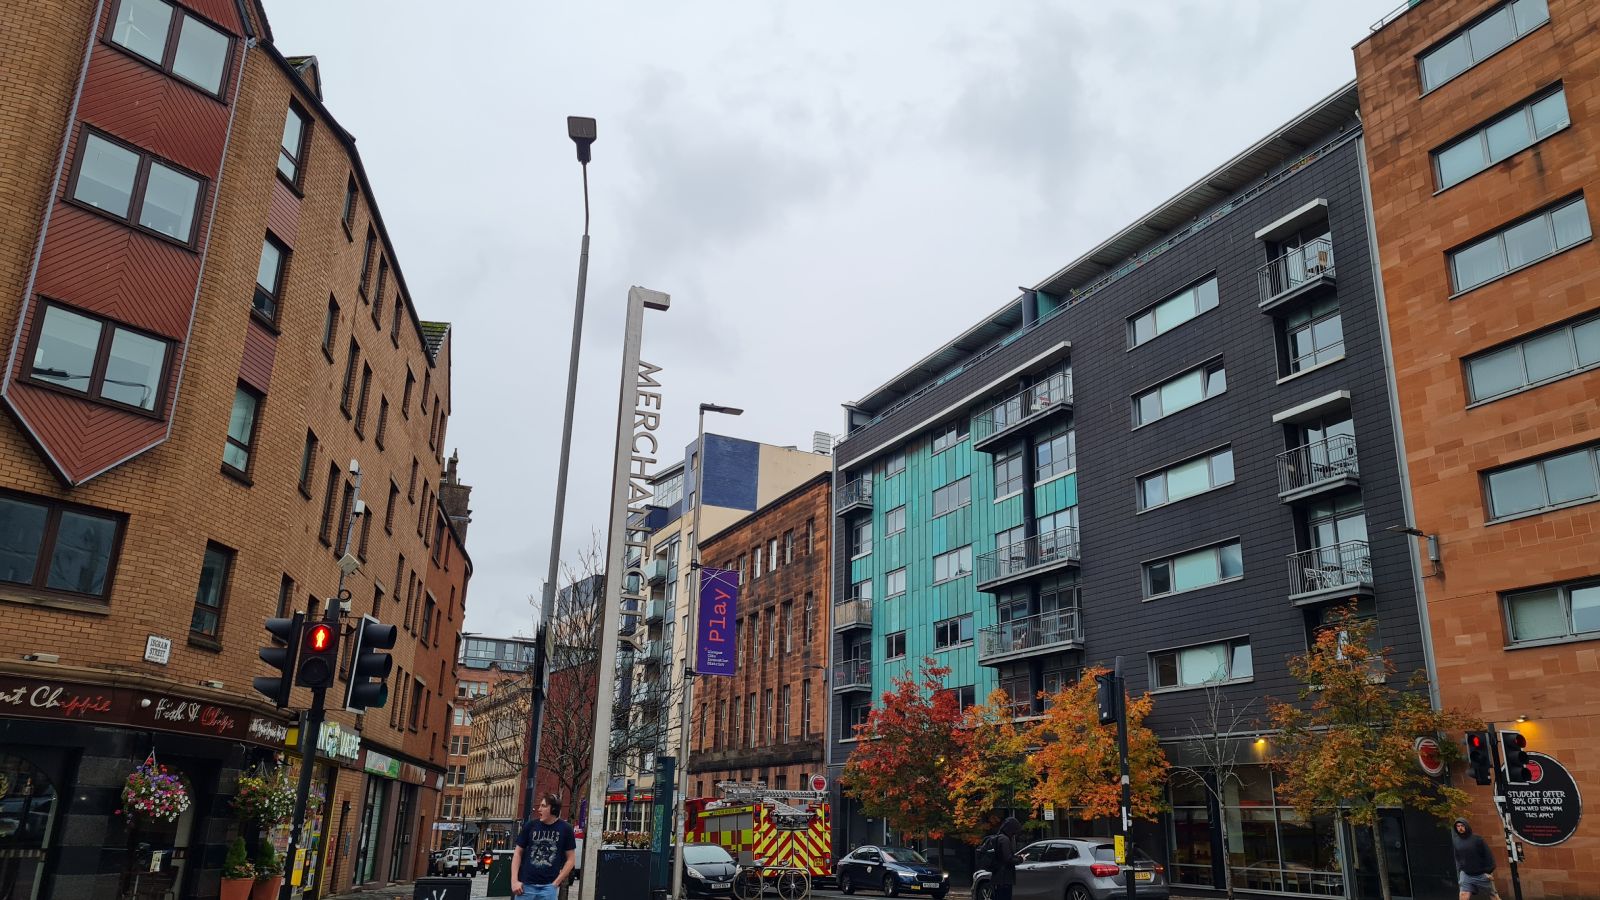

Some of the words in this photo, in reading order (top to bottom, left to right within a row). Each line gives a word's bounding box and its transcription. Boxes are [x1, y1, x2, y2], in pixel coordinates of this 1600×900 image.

[625, 360, 663, 557] MERCHANT
[618, 567, 648, 653] CITY
[709, 588, 731, 642] Play
[149, 648, 166, 657] STREET
[30, 685, 112, 716] Chippie
[155, 698, 187, 721] Fish
[201, 706, 235, 733] Chips
[340, 731, 361, 760] VAPE
